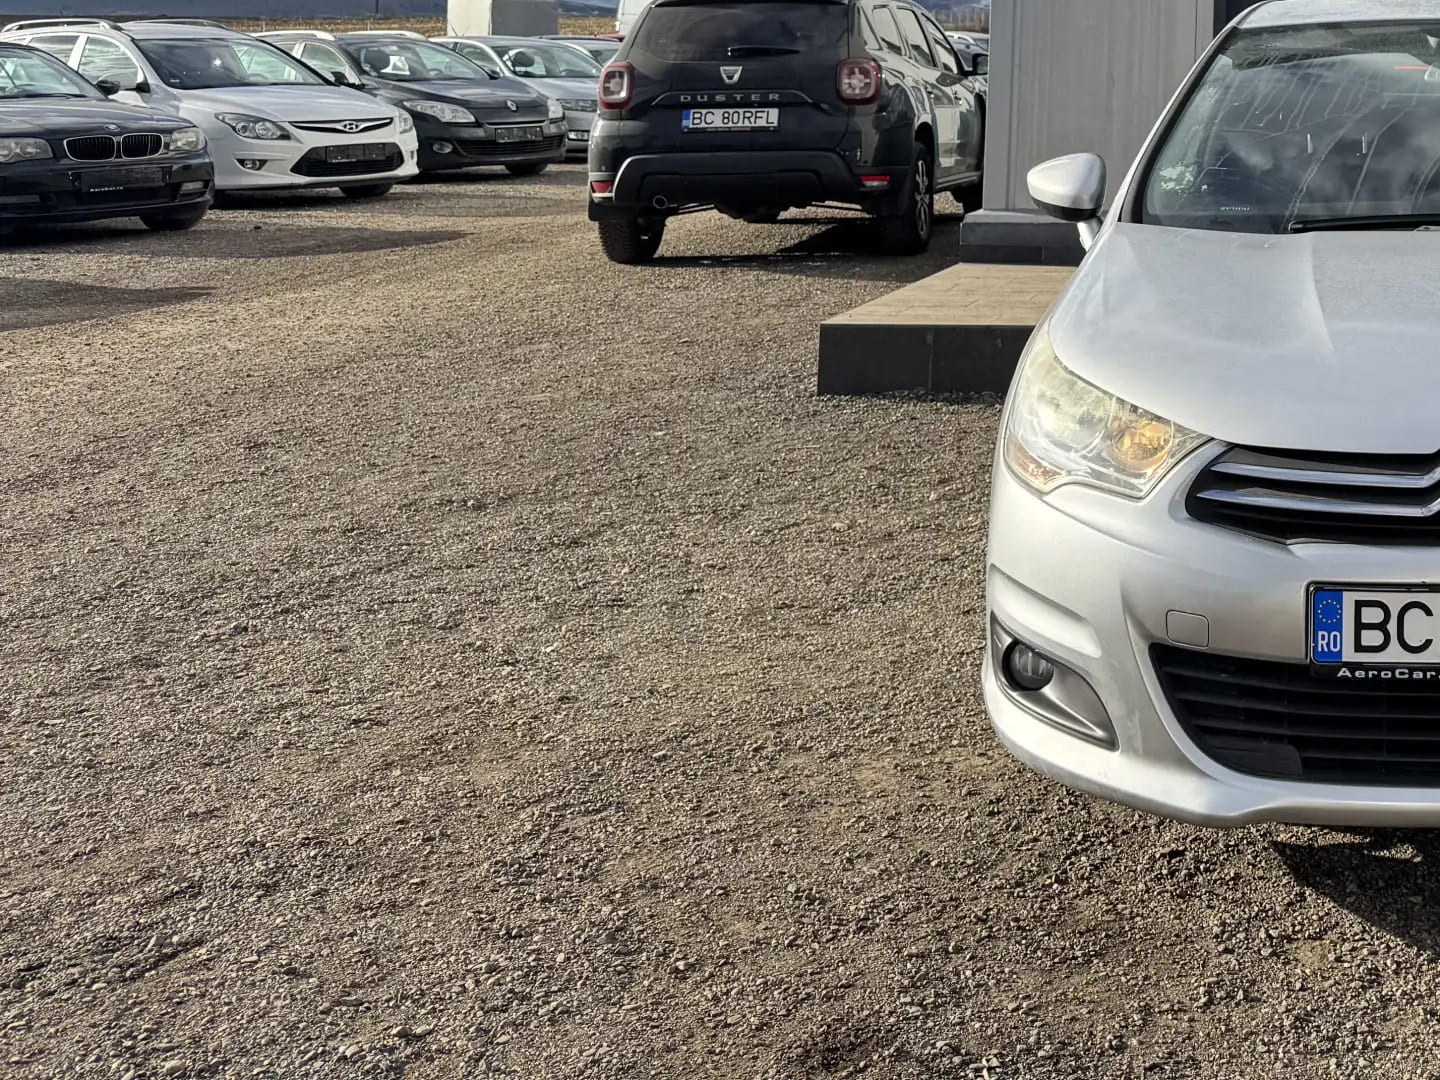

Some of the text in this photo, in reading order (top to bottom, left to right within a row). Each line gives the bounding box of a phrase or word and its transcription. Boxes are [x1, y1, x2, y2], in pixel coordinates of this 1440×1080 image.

[680, 93, 780, 102] DUSTER
[691, 111, 715, 126] BC
[721, 110, 775, 125] 80RFL
[1353, 599, 1434, 654] BC
[1317, 630, 1341, 653] RO
